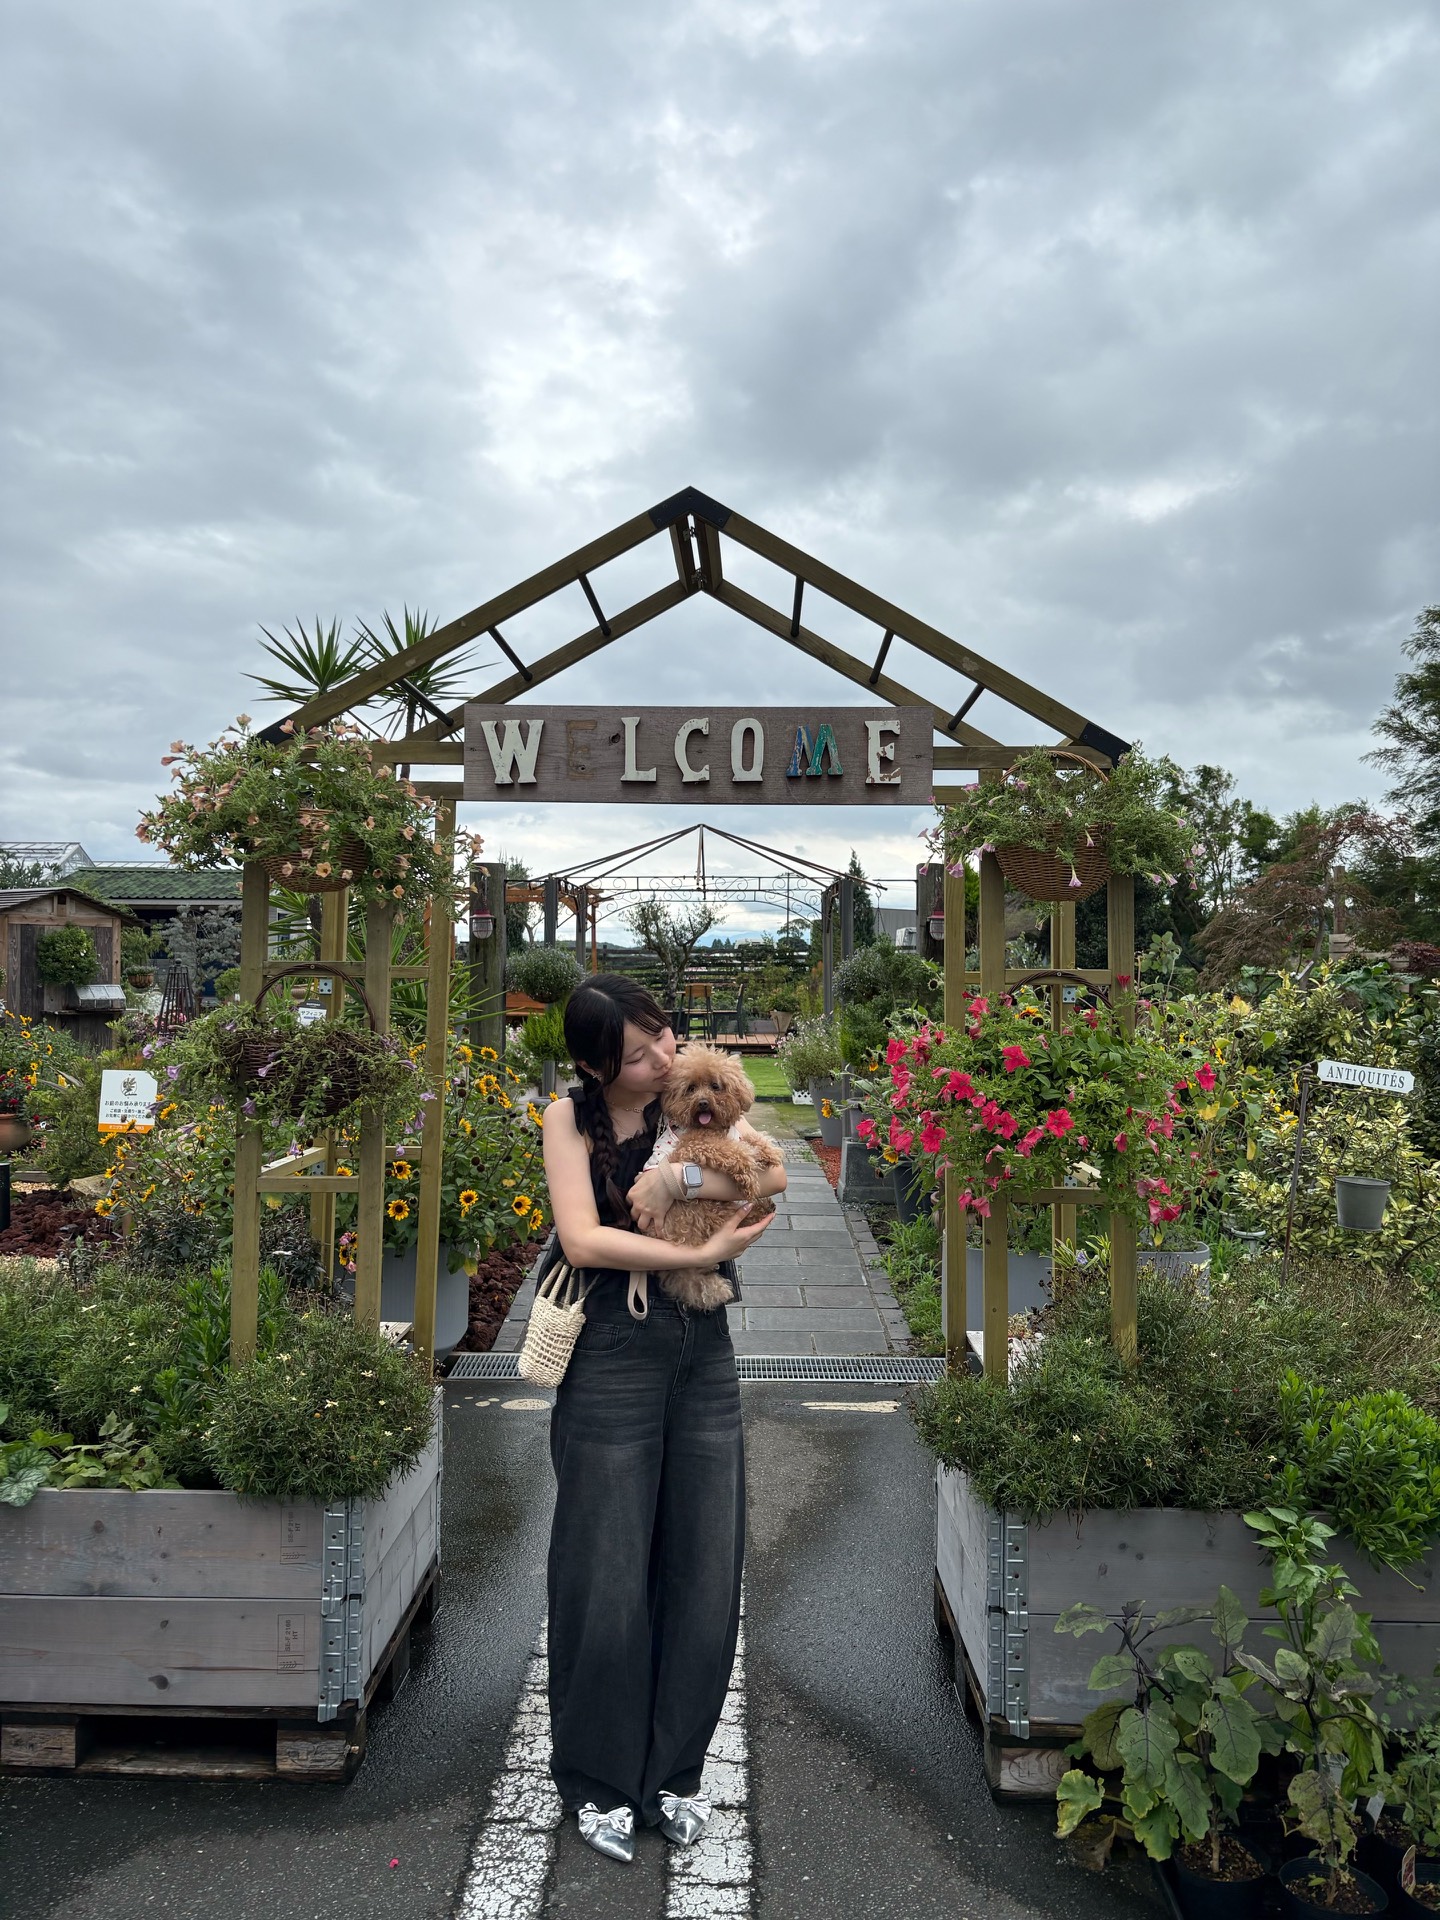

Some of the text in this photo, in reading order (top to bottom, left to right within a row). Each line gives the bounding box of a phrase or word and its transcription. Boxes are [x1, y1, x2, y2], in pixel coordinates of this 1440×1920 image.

[480, 716, 902, 785] WELCOME
[1326, 1065, 1405, 1088] ANTIQUITÉS
[294, 1522, 301, 1532] HT
[292, 1630, 298, 1640] HT
